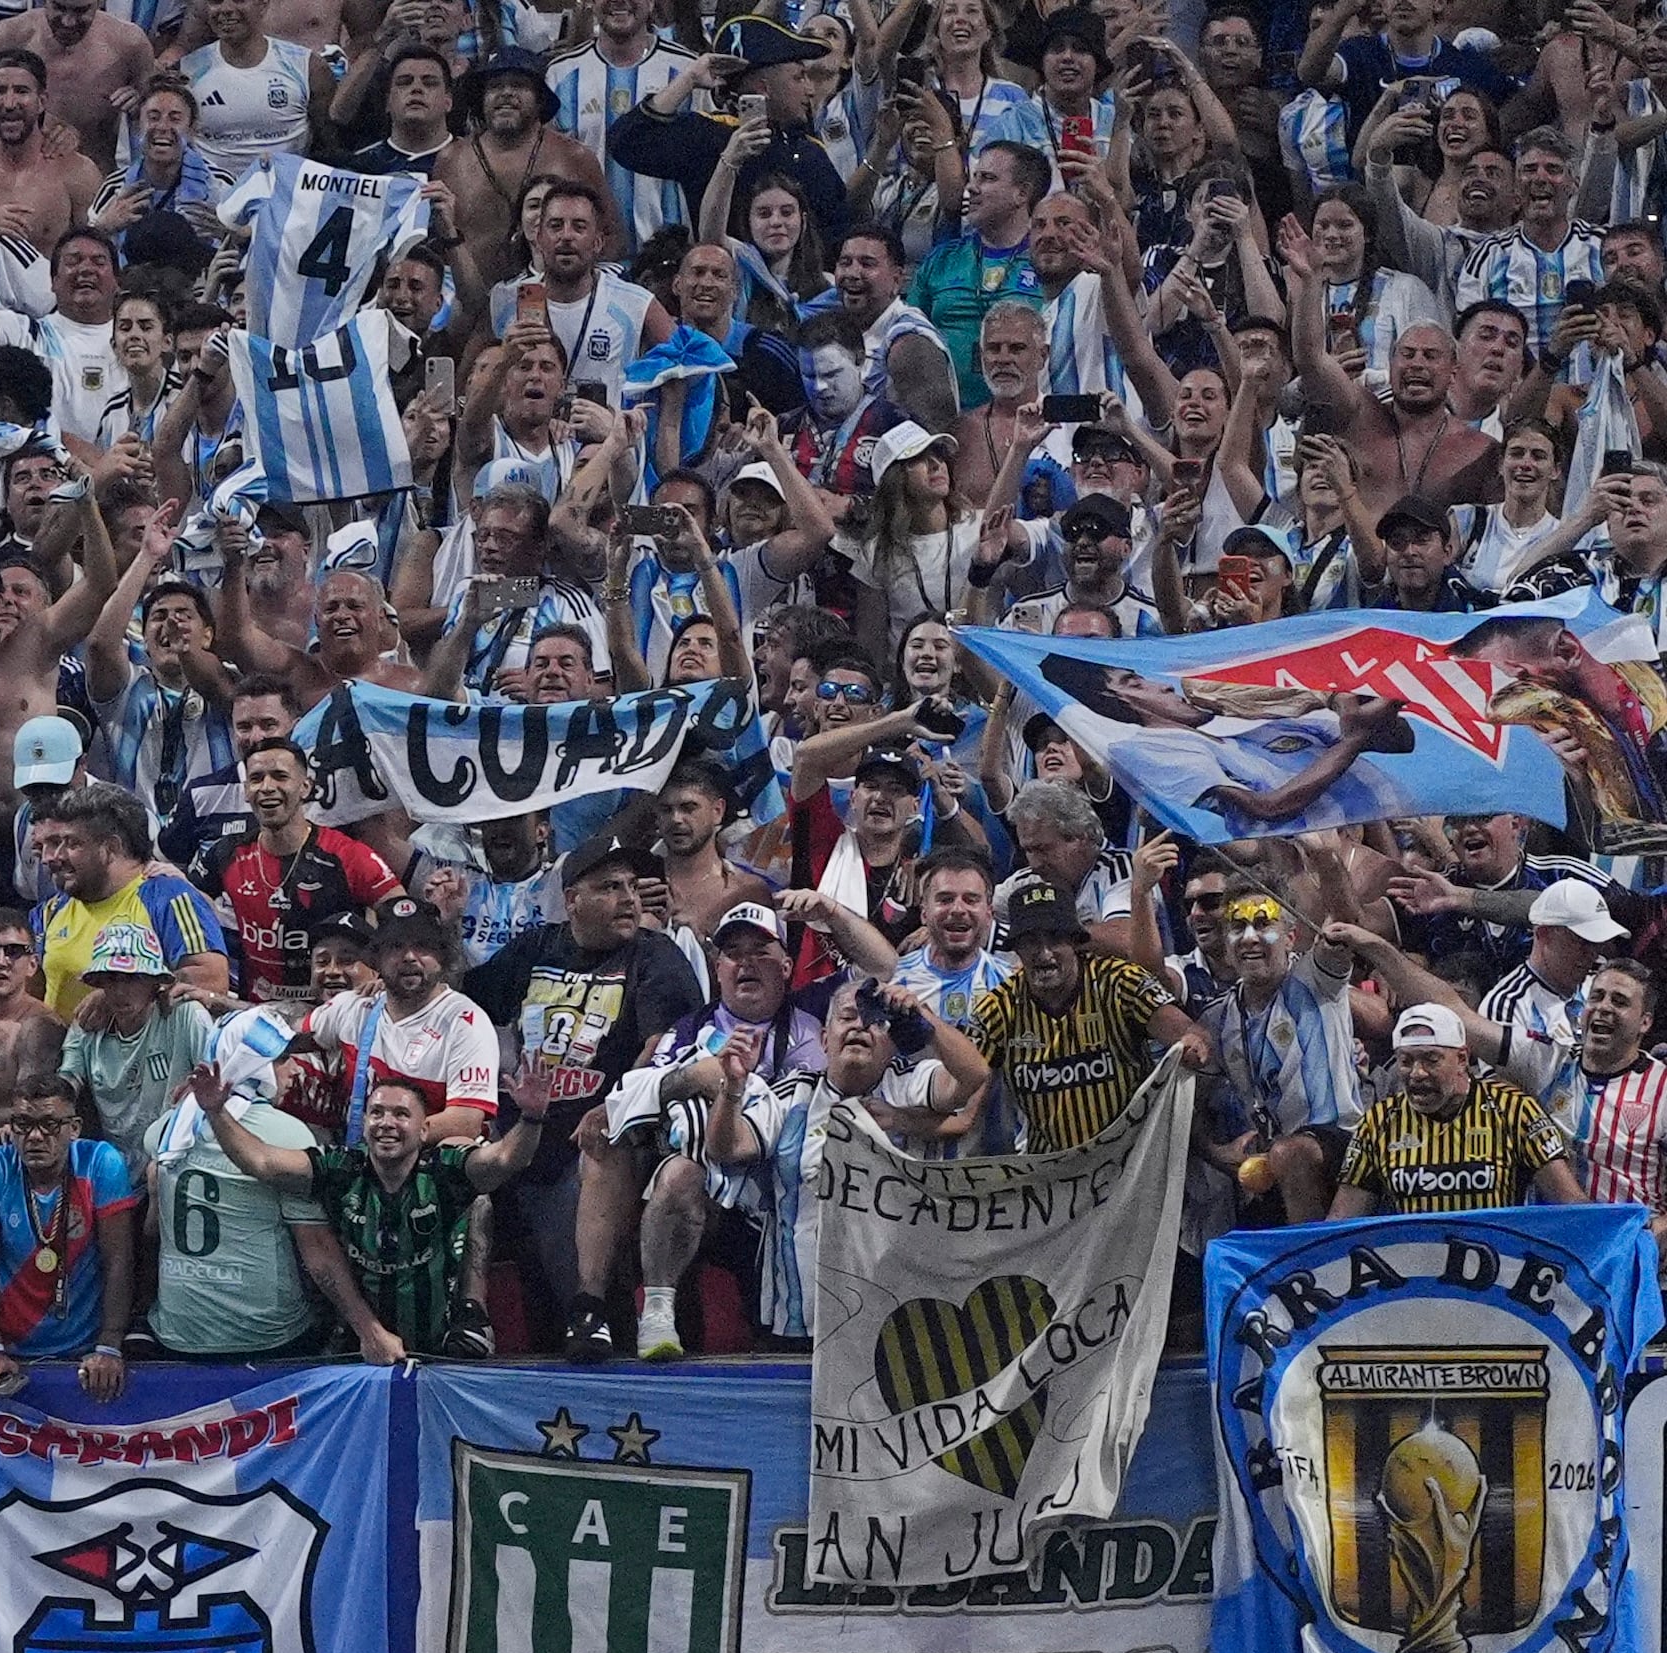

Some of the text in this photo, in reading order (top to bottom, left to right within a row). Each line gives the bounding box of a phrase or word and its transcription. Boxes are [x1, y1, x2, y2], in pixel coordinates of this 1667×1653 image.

[301, 172, 383, 201] MONTIEL
[298, 206, 353, 297] 4
[459, 1066, 490, 1083] UM
[1014, 1050, 1116, 1094] flybondi
[1391, 1165, 1494, 1199] flybondi
[174, 1169, 220, 1257] 6
[814, 1283, 1130, 1474] MI VIDA LOCA
[1548, 1463, 1596, 1491] 2026
